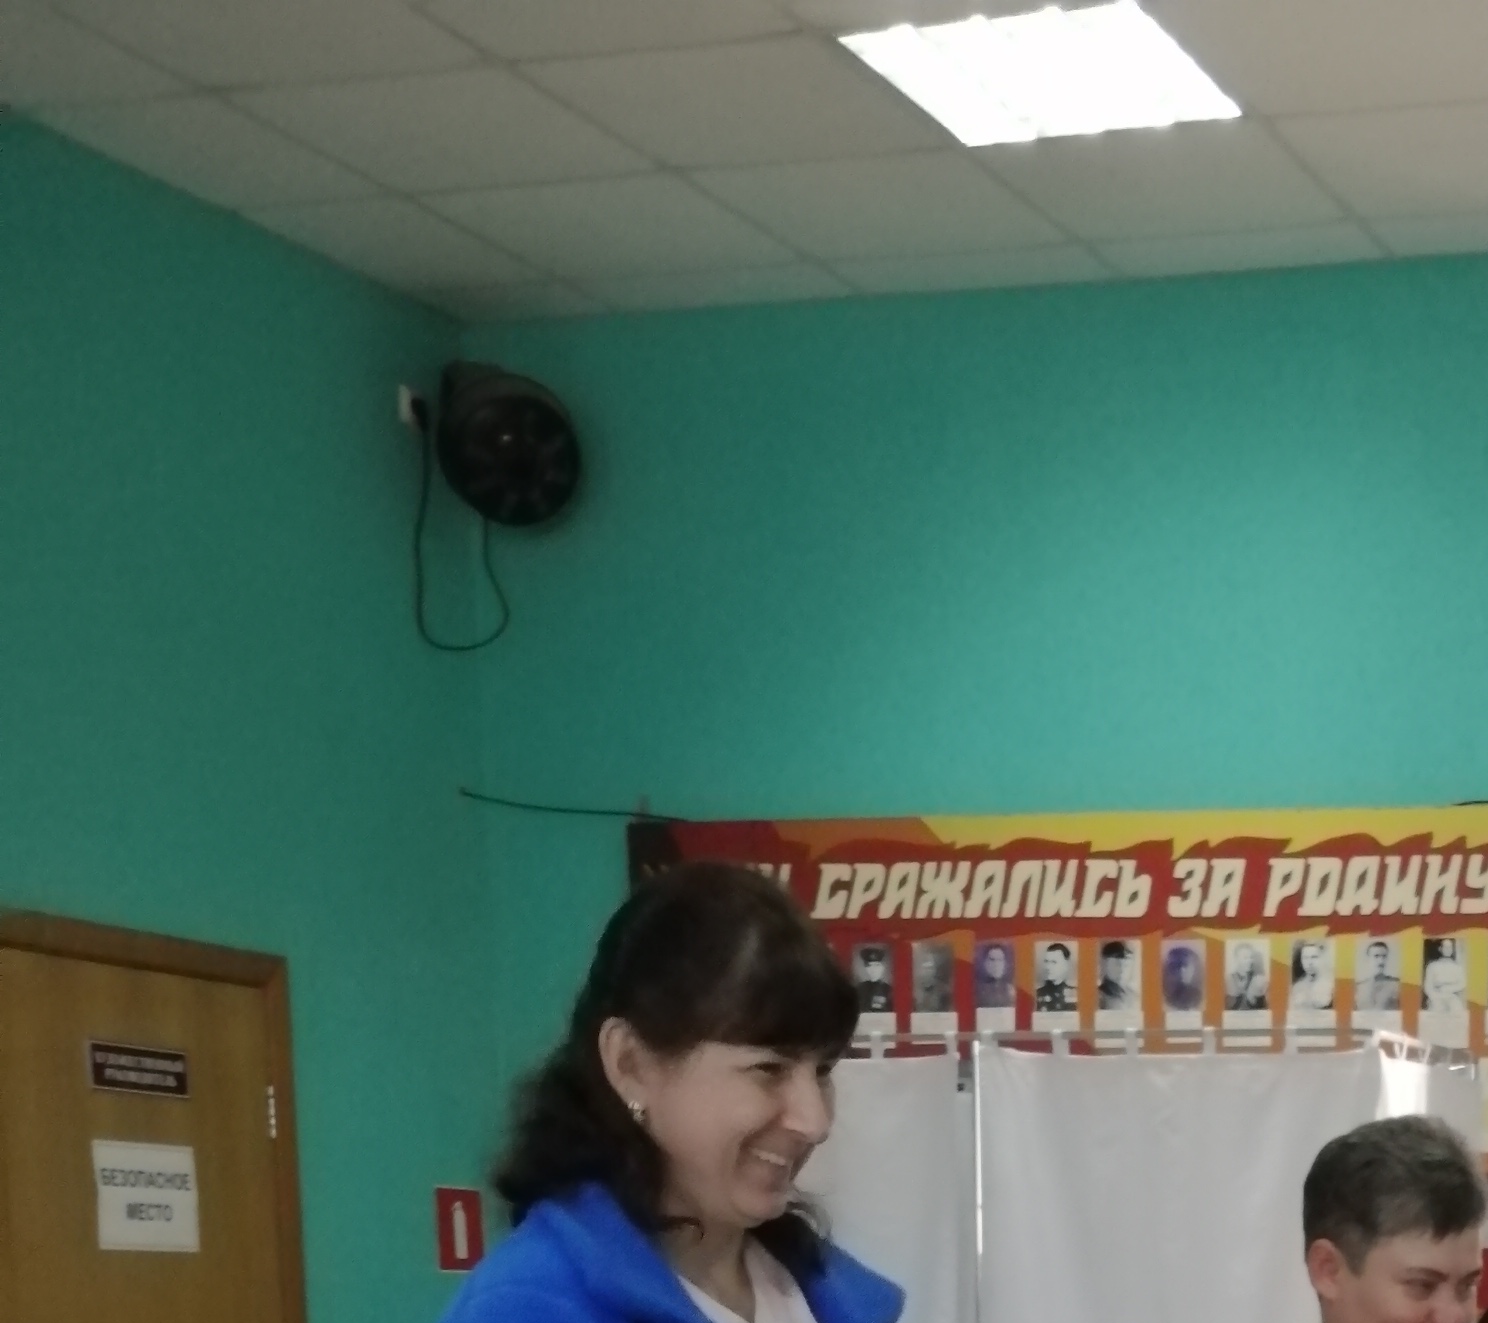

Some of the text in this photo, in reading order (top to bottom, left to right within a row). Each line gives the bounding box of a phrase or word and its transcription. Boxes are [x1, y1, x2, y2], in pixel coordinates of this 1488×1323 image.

[810, 860, 1153, 919] СРАЖАЛИСЬ
[1167, 857, 1248, 918] ЗА
[101, 1168, 191, 1191] БЕЗОПАСНОЕ
[126, 1202, 173, 1222] МЕСТО
